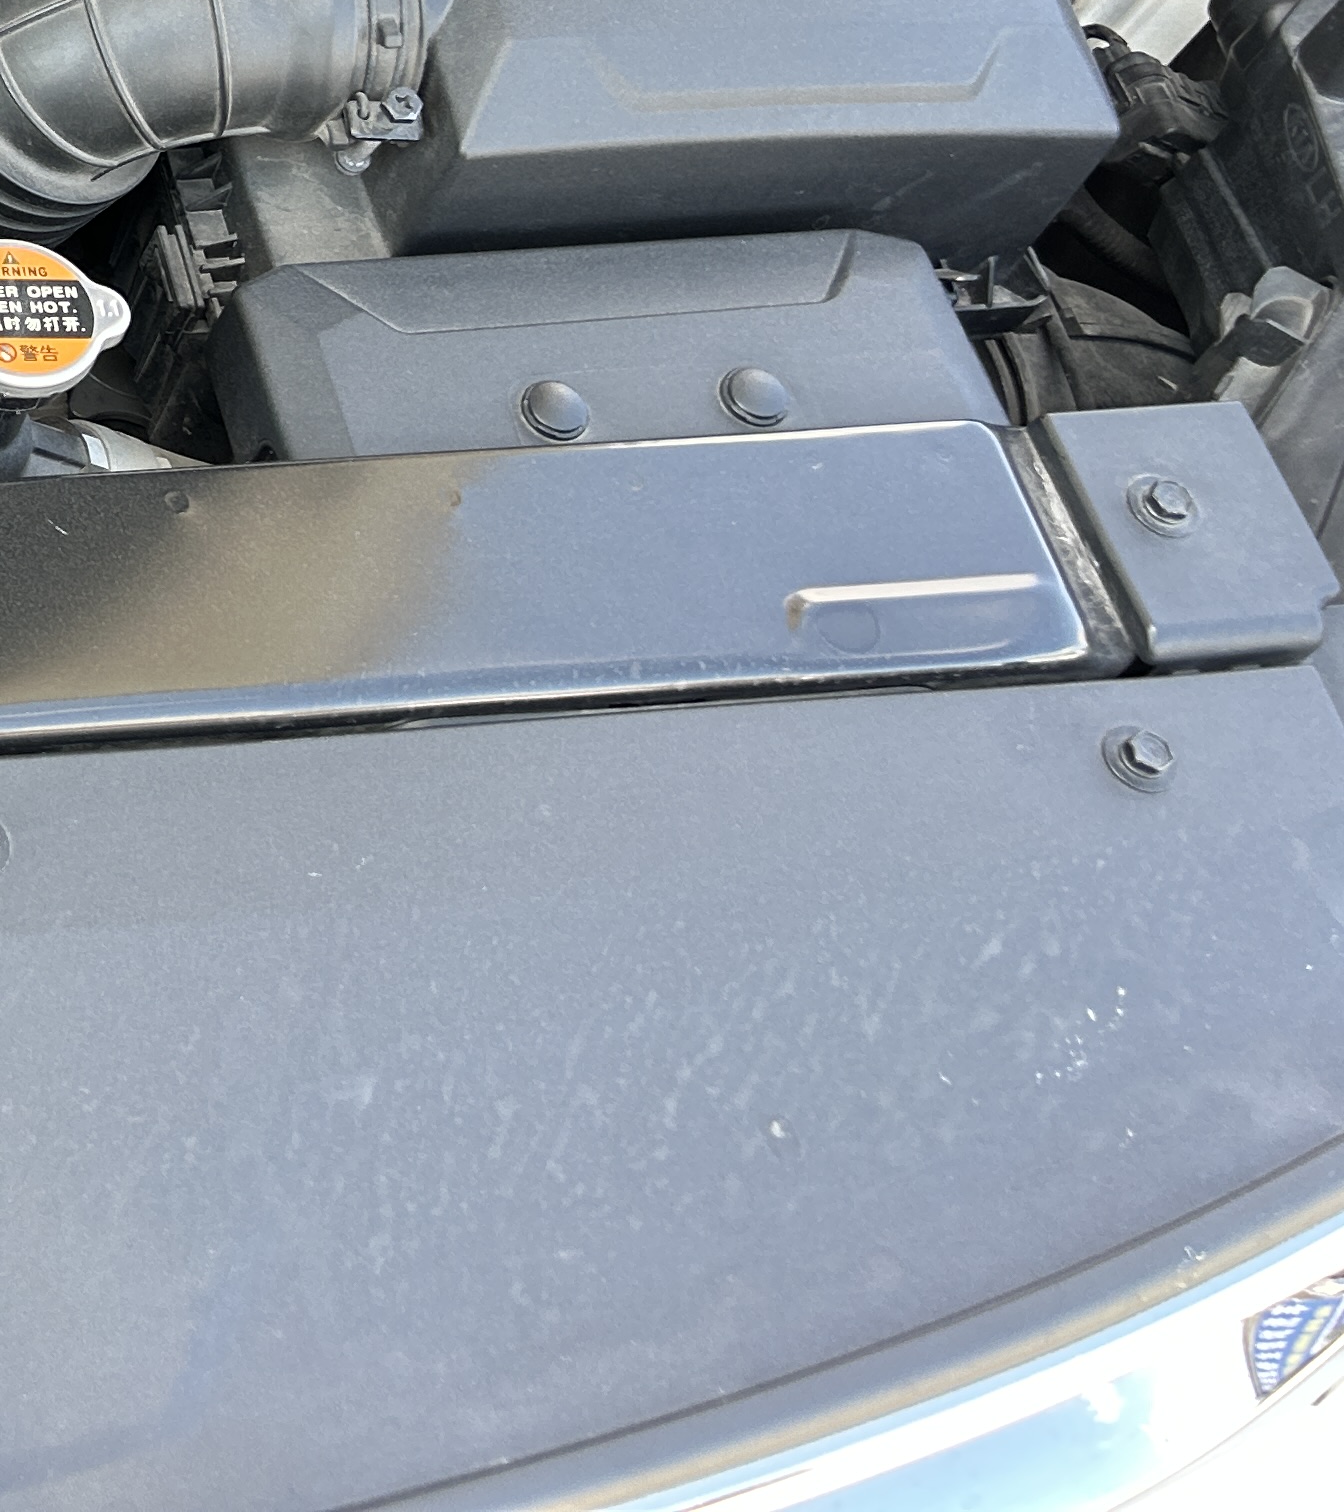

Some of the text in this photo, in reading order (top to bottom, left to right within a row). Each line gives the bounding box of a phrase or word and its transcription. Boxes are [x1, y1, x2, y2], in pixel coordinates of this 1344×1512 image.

[26, 285, 78, 299] OPEN
[30, 300, 78, 313] HOT.
[19, 344, 59, 362] 警告
